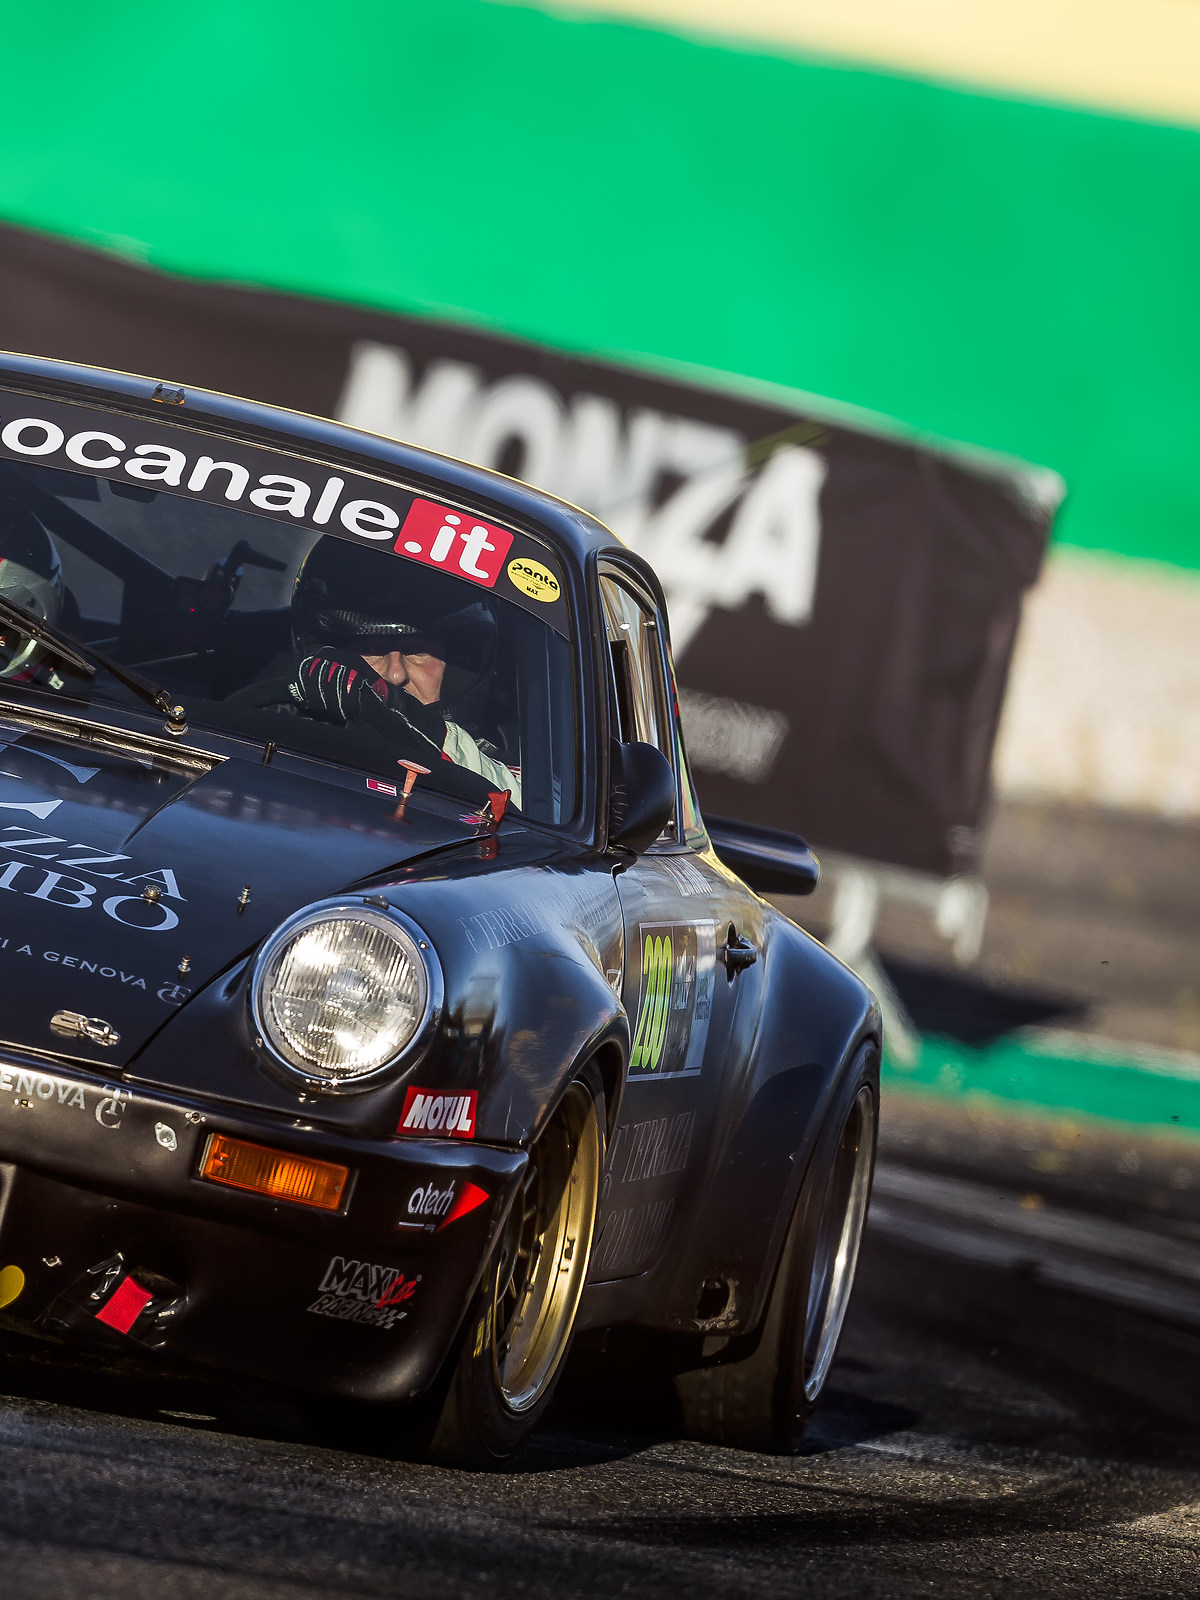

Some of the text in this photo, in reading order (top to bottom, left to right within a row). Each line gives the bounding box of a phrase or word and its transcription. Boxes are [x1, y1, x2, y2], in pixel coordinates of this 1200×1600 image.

[16, 944, 42, 956] A
[42, 950, 147, 990] GENOVA
[629, 934, 672, 1069] 200
[402, 1093, 472, 1132] MOTUL
